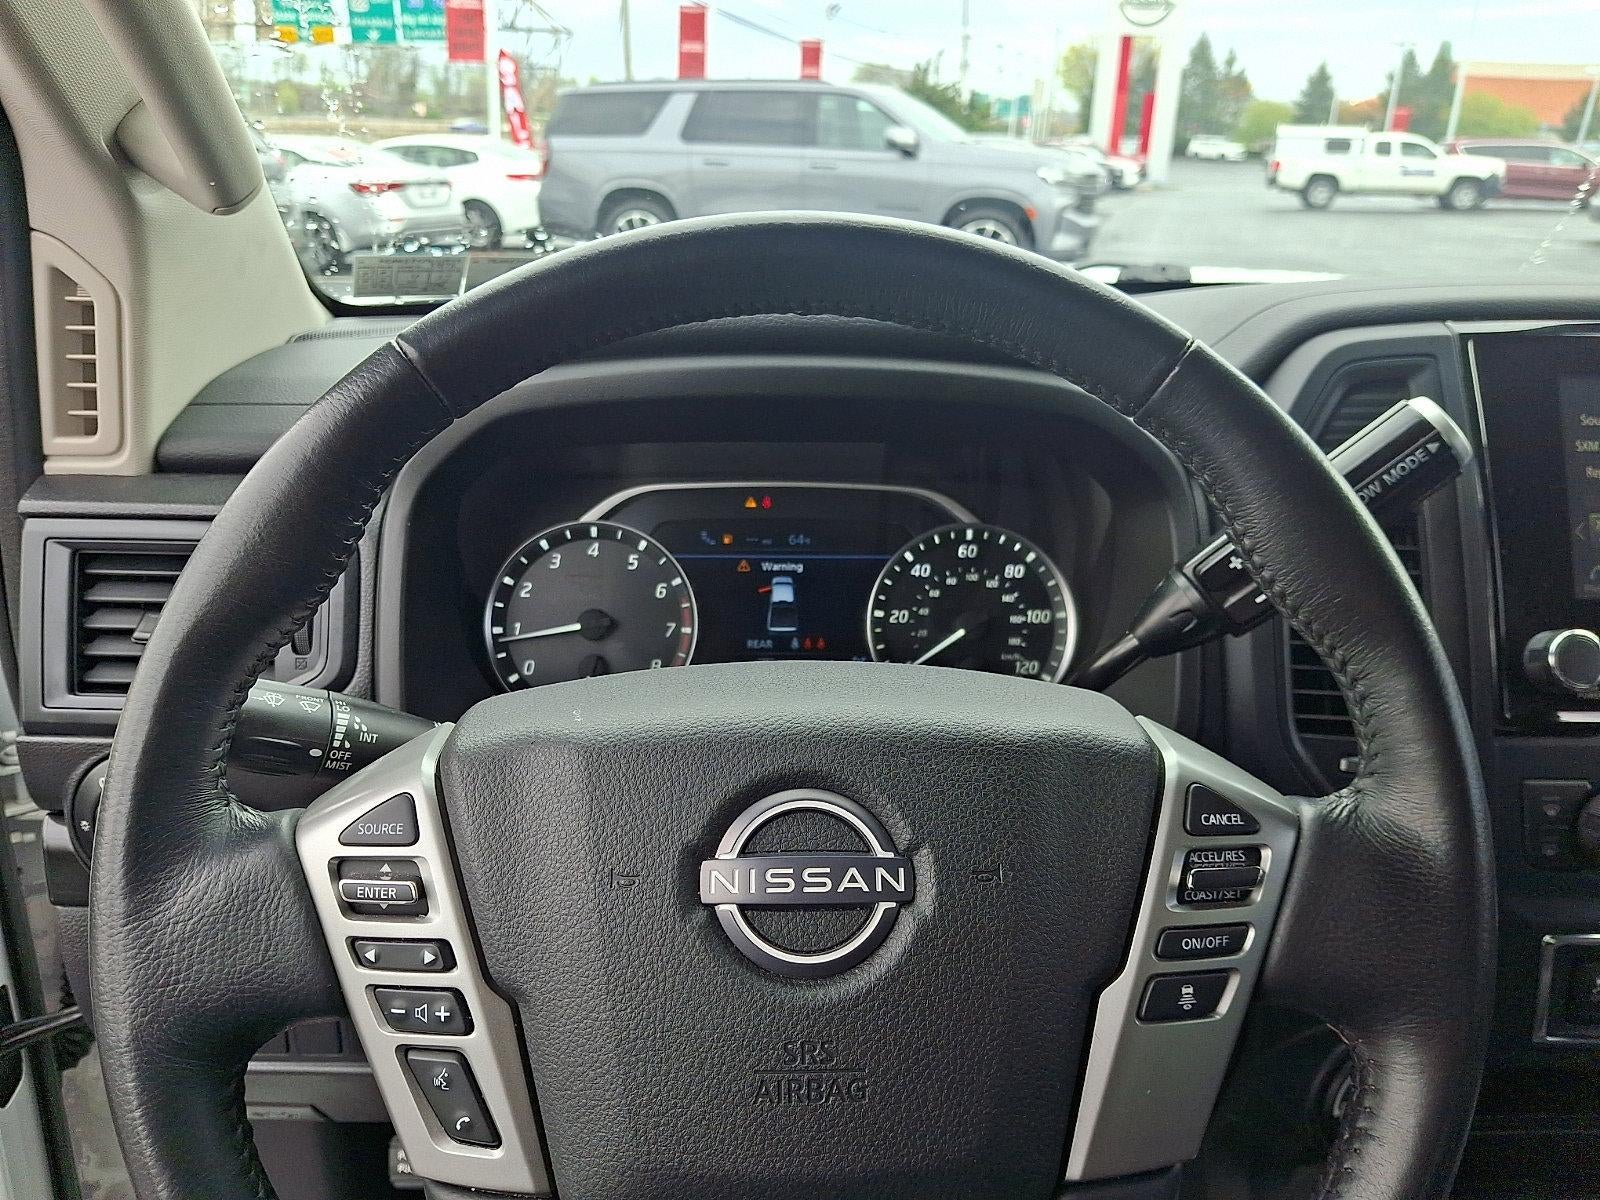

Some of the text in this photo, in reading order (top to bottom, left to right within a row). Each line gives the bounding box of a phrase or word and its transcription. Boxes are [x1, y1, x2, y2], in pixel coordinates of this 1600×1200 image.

[1382, 447, 1430, 486] MODE
[587, 542, 600, 558] 4
[957, 544, 978, 559] 60
[549, 553, 561, 569] 3
[627, 554, 639, 570] 5
[761, 562, 804, 573] Warning
[910, 563, 932, 578] 40
[1004, 564, 1026, 579] 80
[520, 582, 532, 598] 2
[655, 583, 667, 599] 6
[889, 609, 910, 624] 20
[1026, 610, 1051, 624] 100
[513, 622, 521, 636] 1
[665, 622, 677, 638] 7
[746, 639, 773, 649] REAR
[523, 659, 536, 676] 0
[1015, 660, 1039, 675] 120
[295, 694, 325, 703] FRONT
[336, 704, 350, 712] LO
[359, 731, 379, 744] INT
[329, 749, 352, 761] OFF
[325, 760, 352, 771] MIST
[1201, 813, 1244, 826] CANCEL
[357, 823, 404, 835] SOURCE
[1188, 850, 1246, 863] ACCEL/RES
[708, 867, 906, 895] NISSAN
[356, 886, 397, 899] ENTER
[1184, 889, 1241, 901] COAST/SET
[1181, 935, 1230, 951] ON/OFF
[783, 1040, 838, 1066] SRS
[752, 1078, 868, 1106] AIRBAG
